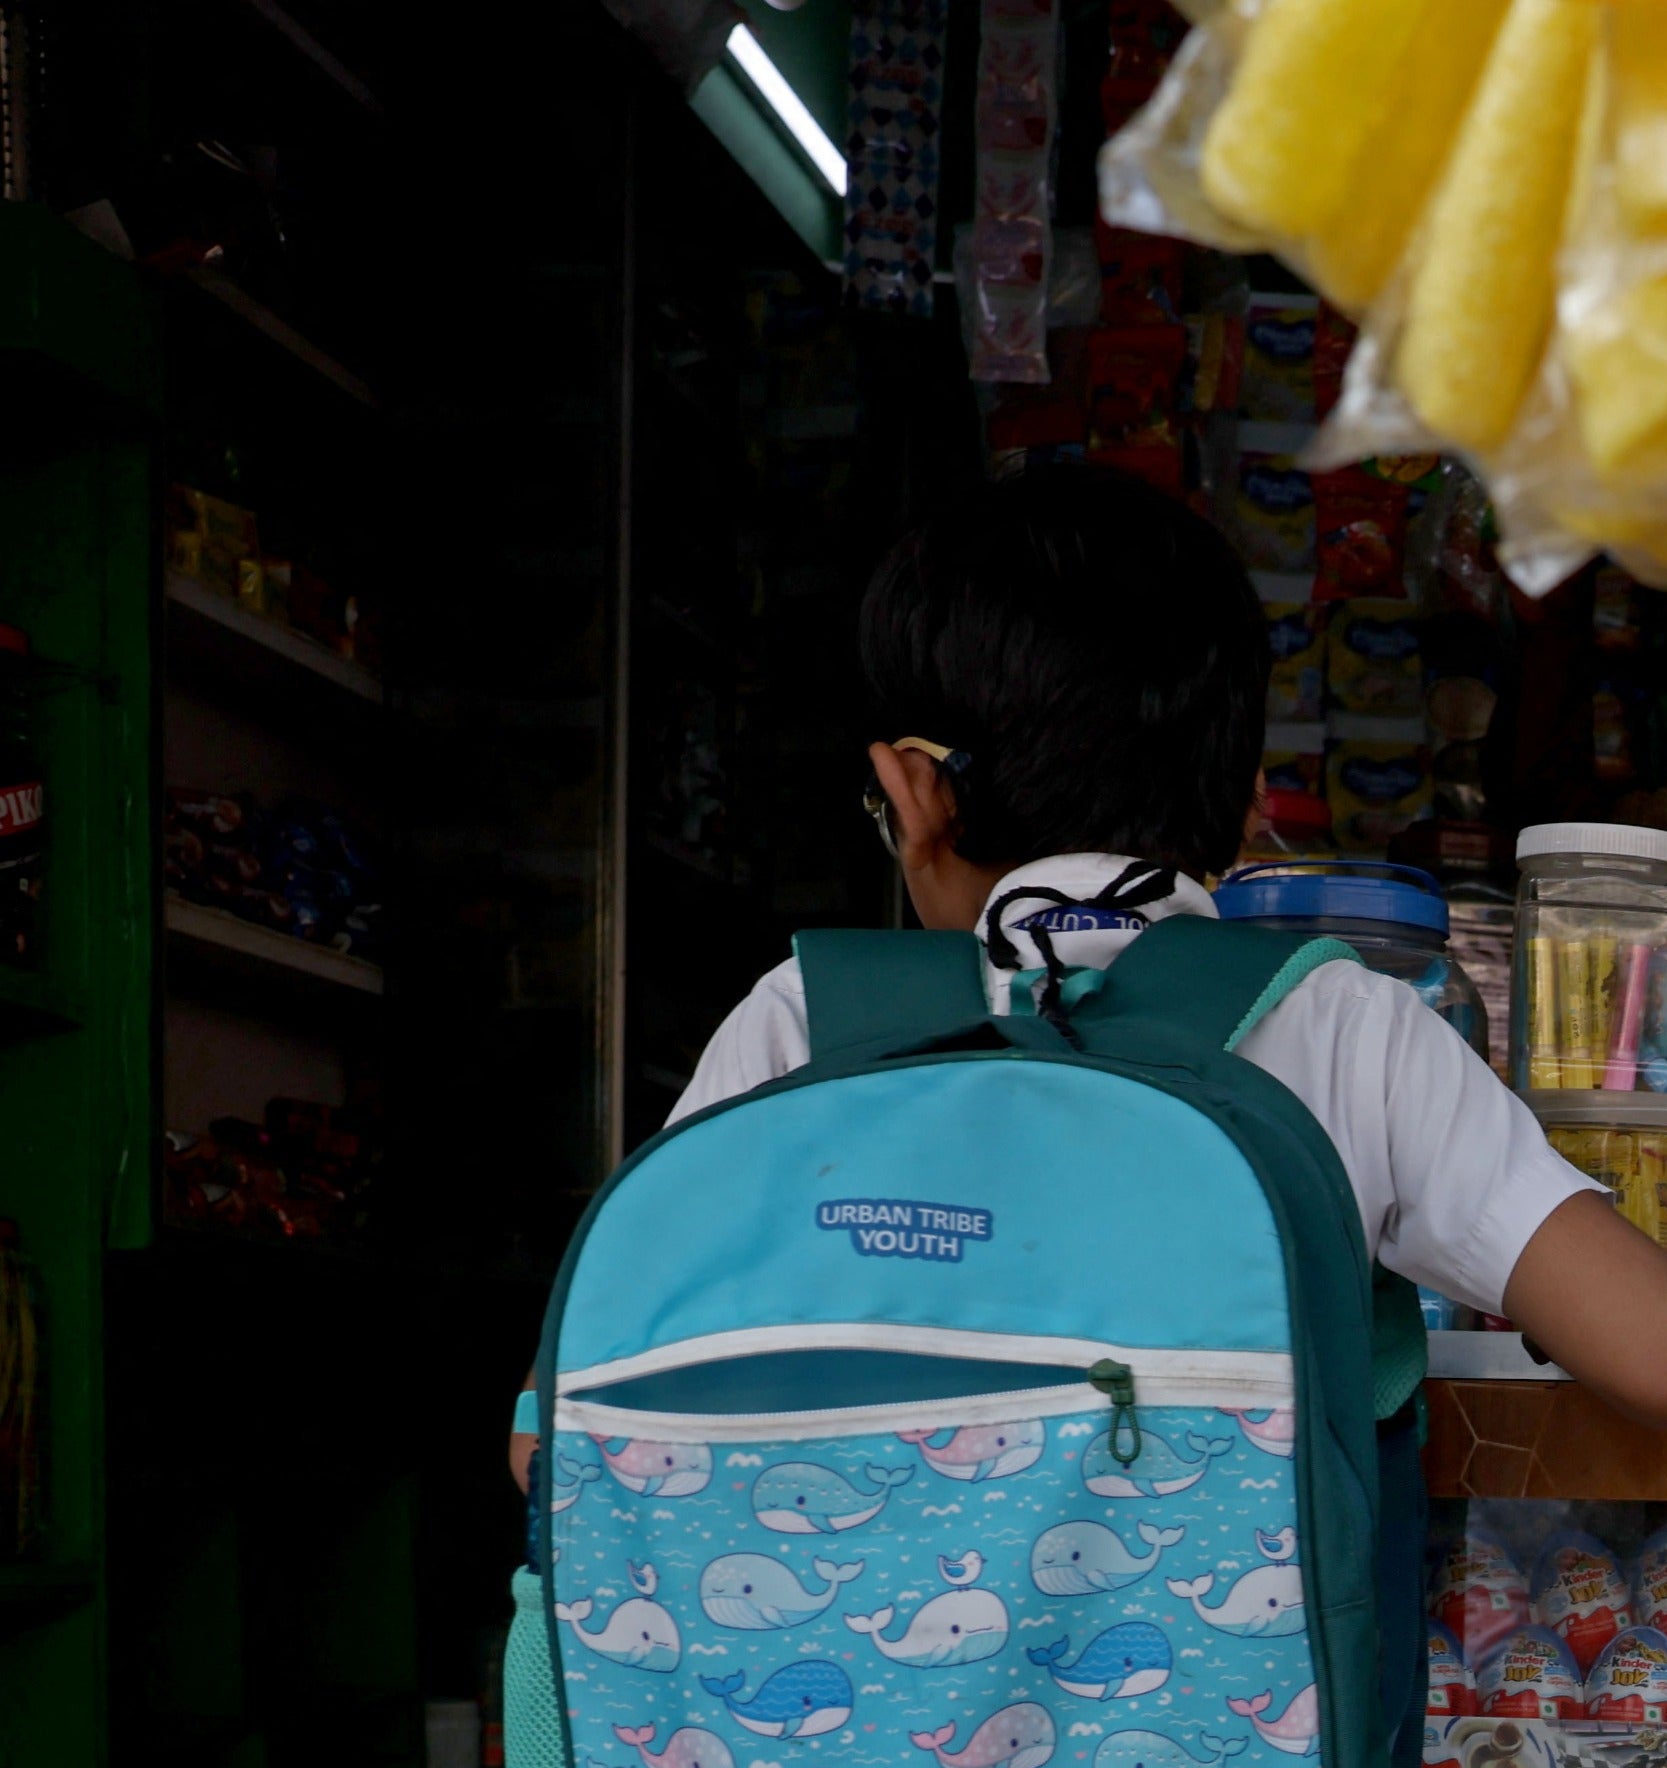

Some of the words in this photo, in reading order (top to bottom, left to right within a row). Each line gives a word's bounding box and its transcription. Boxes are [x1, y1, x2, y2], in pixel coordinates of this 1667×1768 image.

[821, 1205, 913, 1228] URBAN
[917, 1208, 988, 1235] TRIBE
[857, 1229, 959, 1257] YOUTH
